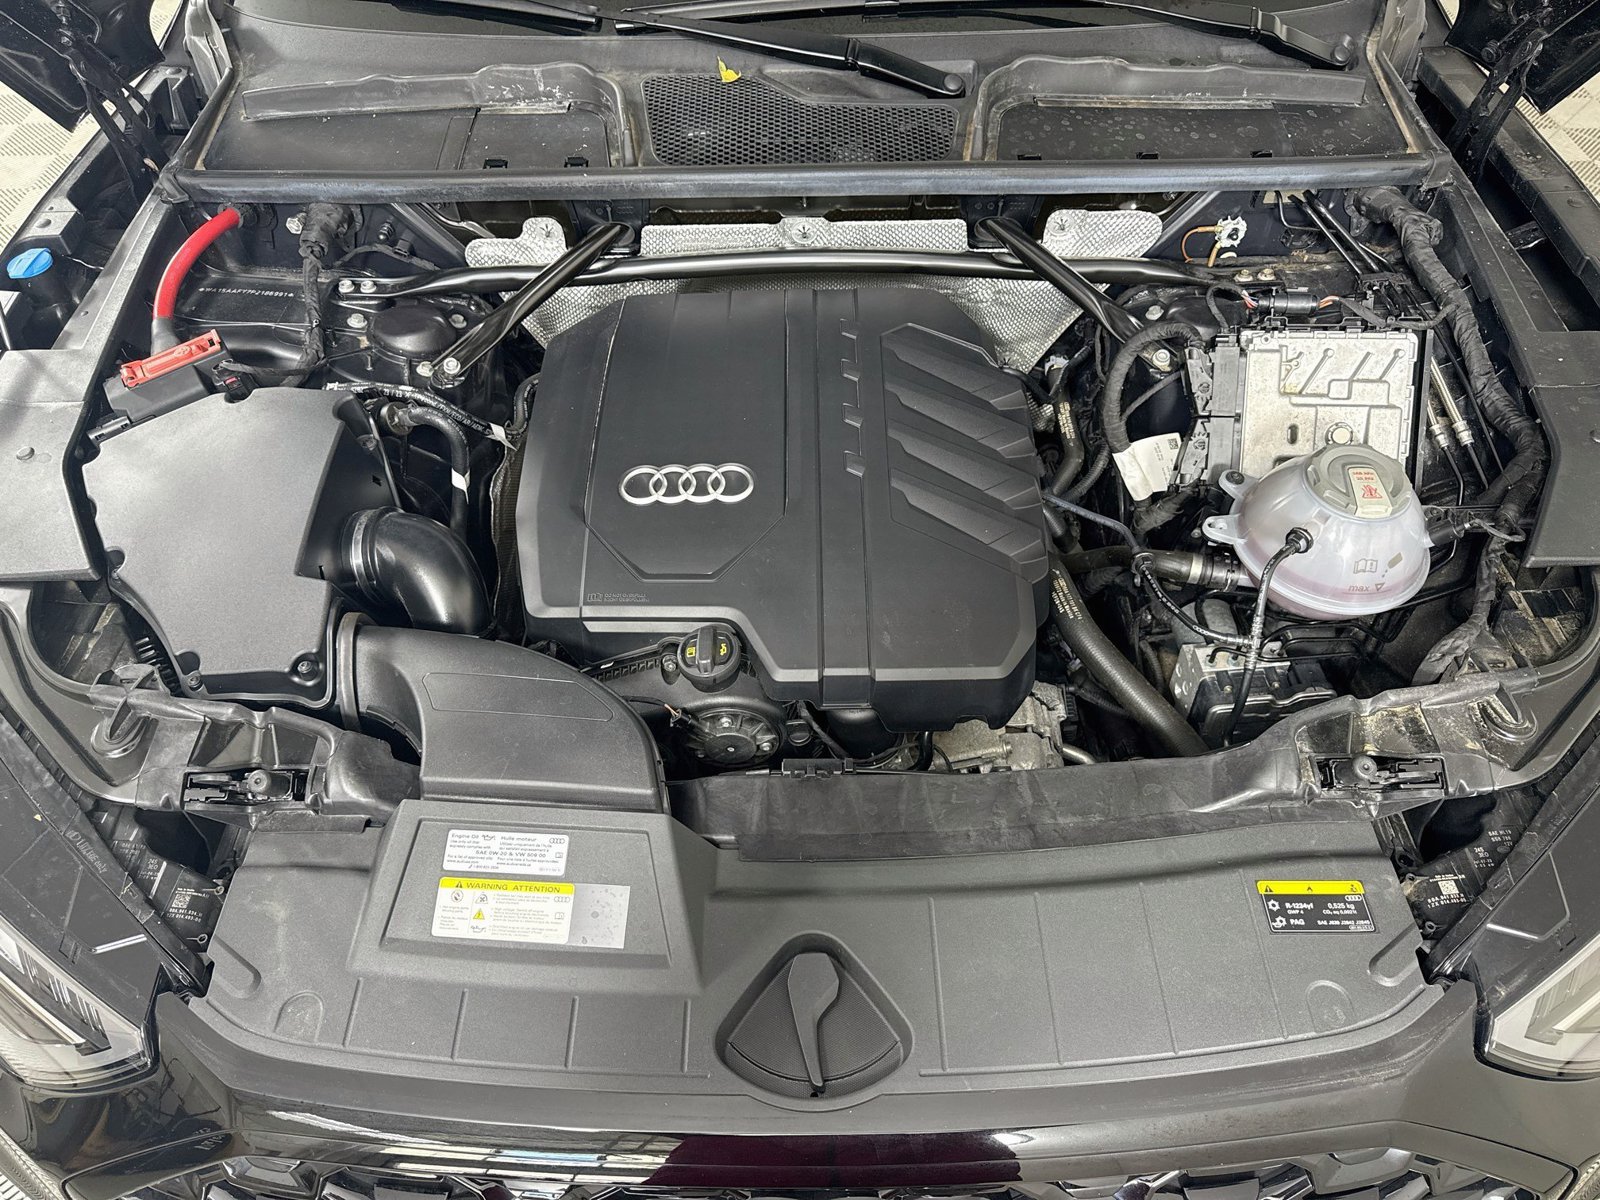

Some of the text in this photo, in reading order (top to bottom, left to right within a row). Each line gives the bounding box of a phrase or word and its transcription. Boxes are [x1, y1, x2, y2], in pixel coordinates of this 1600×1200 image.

[1348, 584, 1370, 592] max
[466, 883, 561, 893] WARNING ATTENTION
